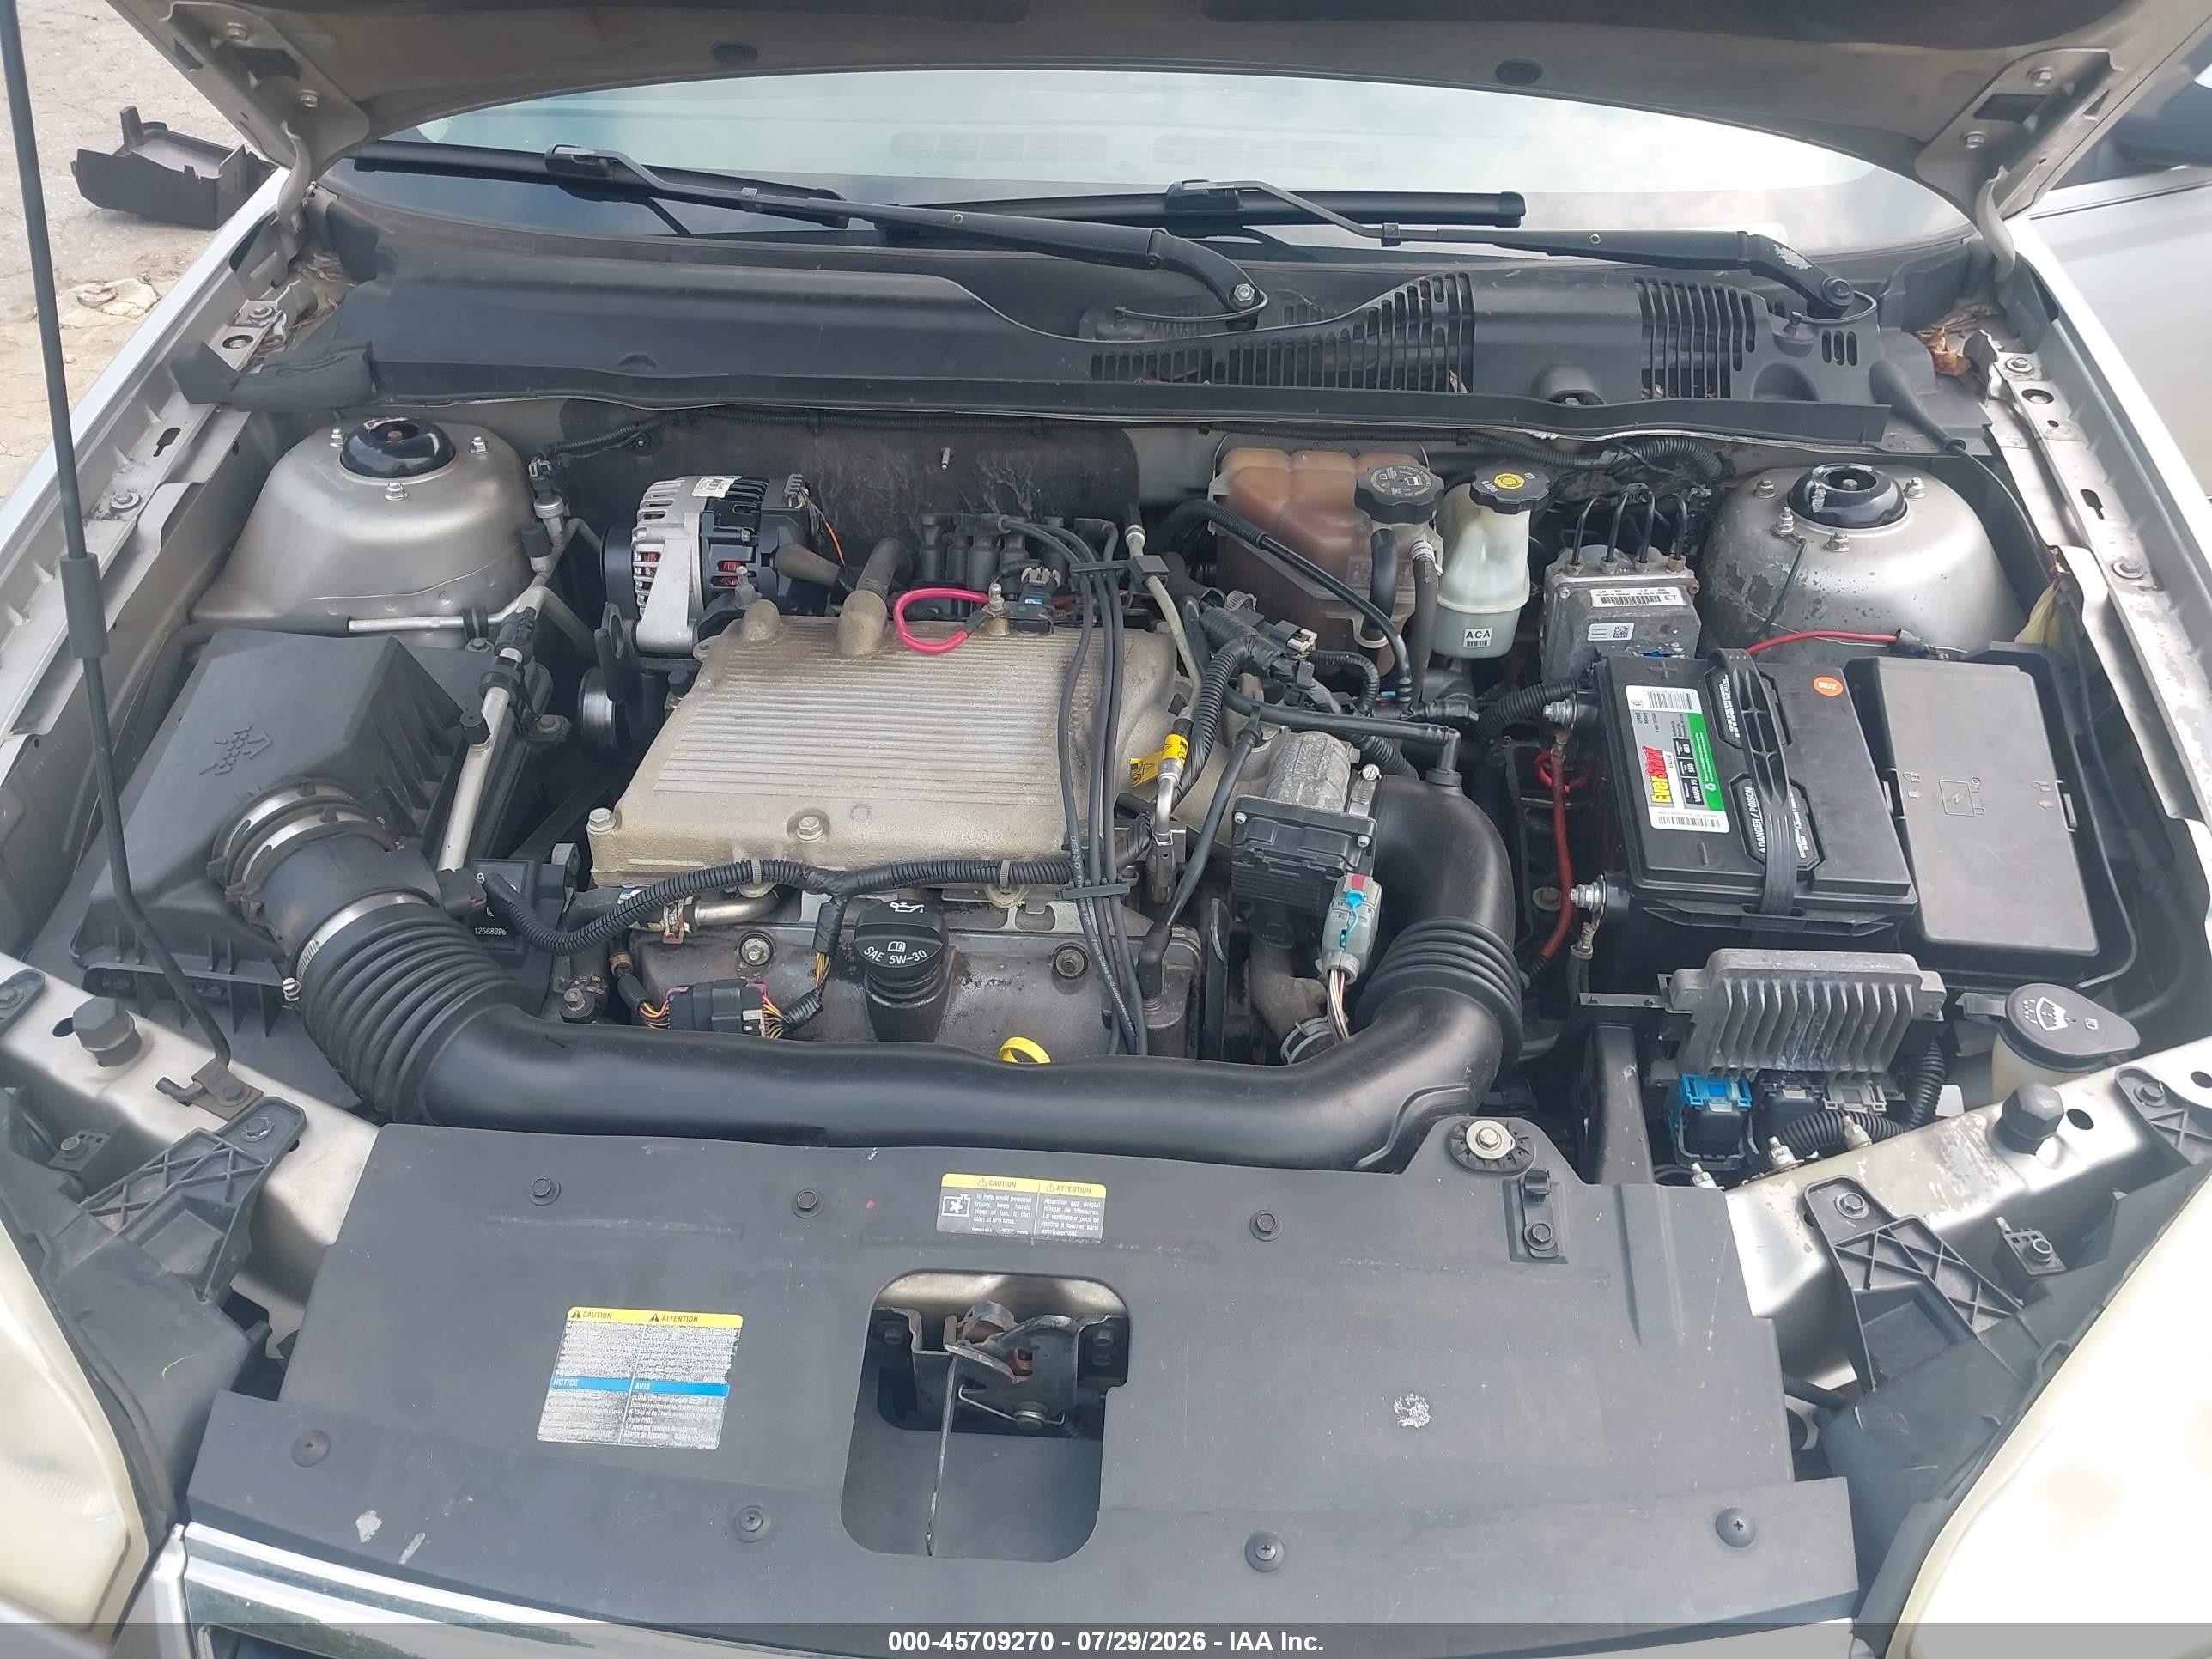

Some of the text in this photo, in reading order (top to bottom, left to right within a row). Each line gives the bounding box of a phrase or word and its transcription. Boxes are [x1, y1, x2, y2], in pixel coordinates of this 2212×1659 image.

[1466, 630, 1491, 639] ACA
[1642, 745, 1674, 803] EverStart
[1745, 787, 1759, 812] POISON
[1070, 835, 1081, 870] DENSO
[864, 946, 927, 964] SAE 5W-30
[1056, 1185, 1091, 1194] ATTENTION
[661, 1315, 698, 1323] ATTENTION
[553, 1378, 579, 1387] NOTICE
[635, 1382, 651, 1390] AVIS
